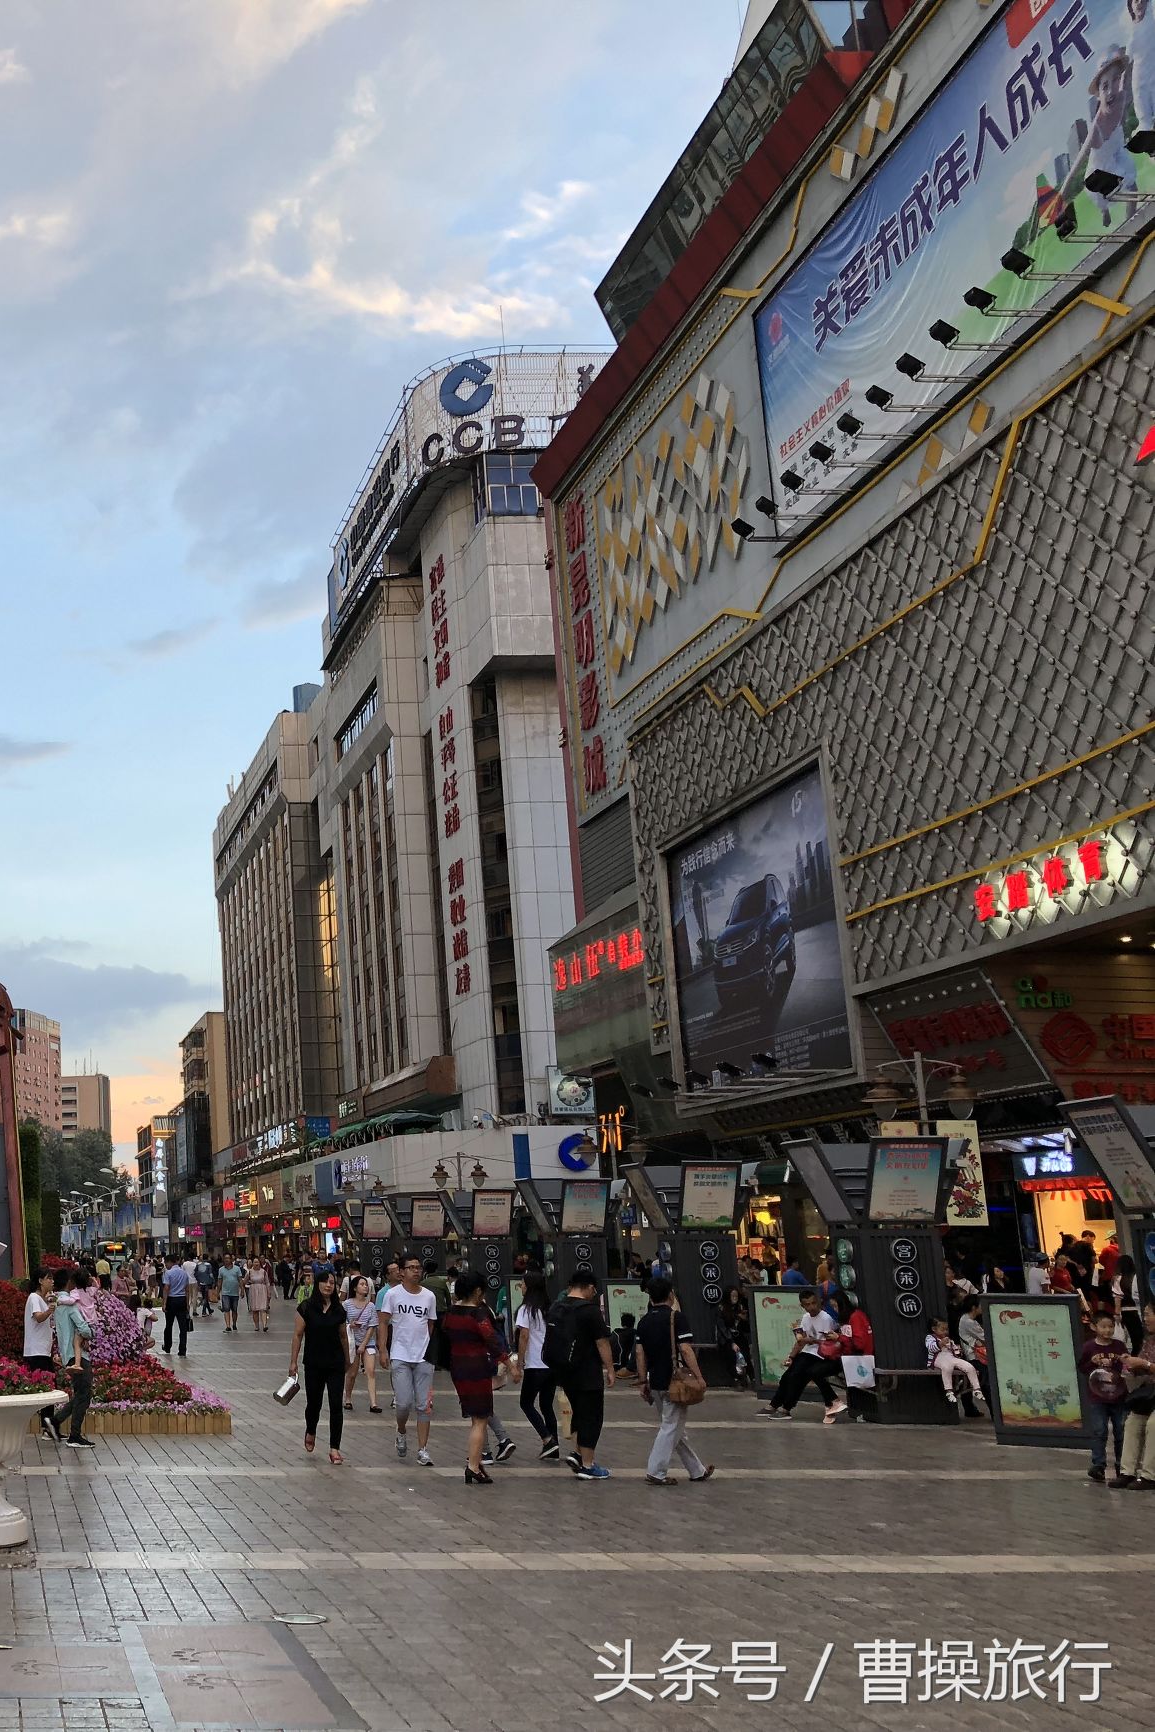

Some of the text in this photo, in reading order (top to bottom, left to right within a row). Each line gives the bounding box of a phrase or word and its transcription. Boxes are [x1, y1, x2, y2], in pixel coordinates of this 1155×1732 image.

[811, 0, 1094, 353] 关爱未成年人成长
[421, 414, 525, 468] CCB
[779, 378, 851, 460] 社会主义核心价值观
[564, 490, 607, 796] 新昆明影城
[680, 831, 735, 877] 为践行信念而来
[973, 840, 1104, 923] 安踏体育
[398, 1304, 428, 1316] NASA
